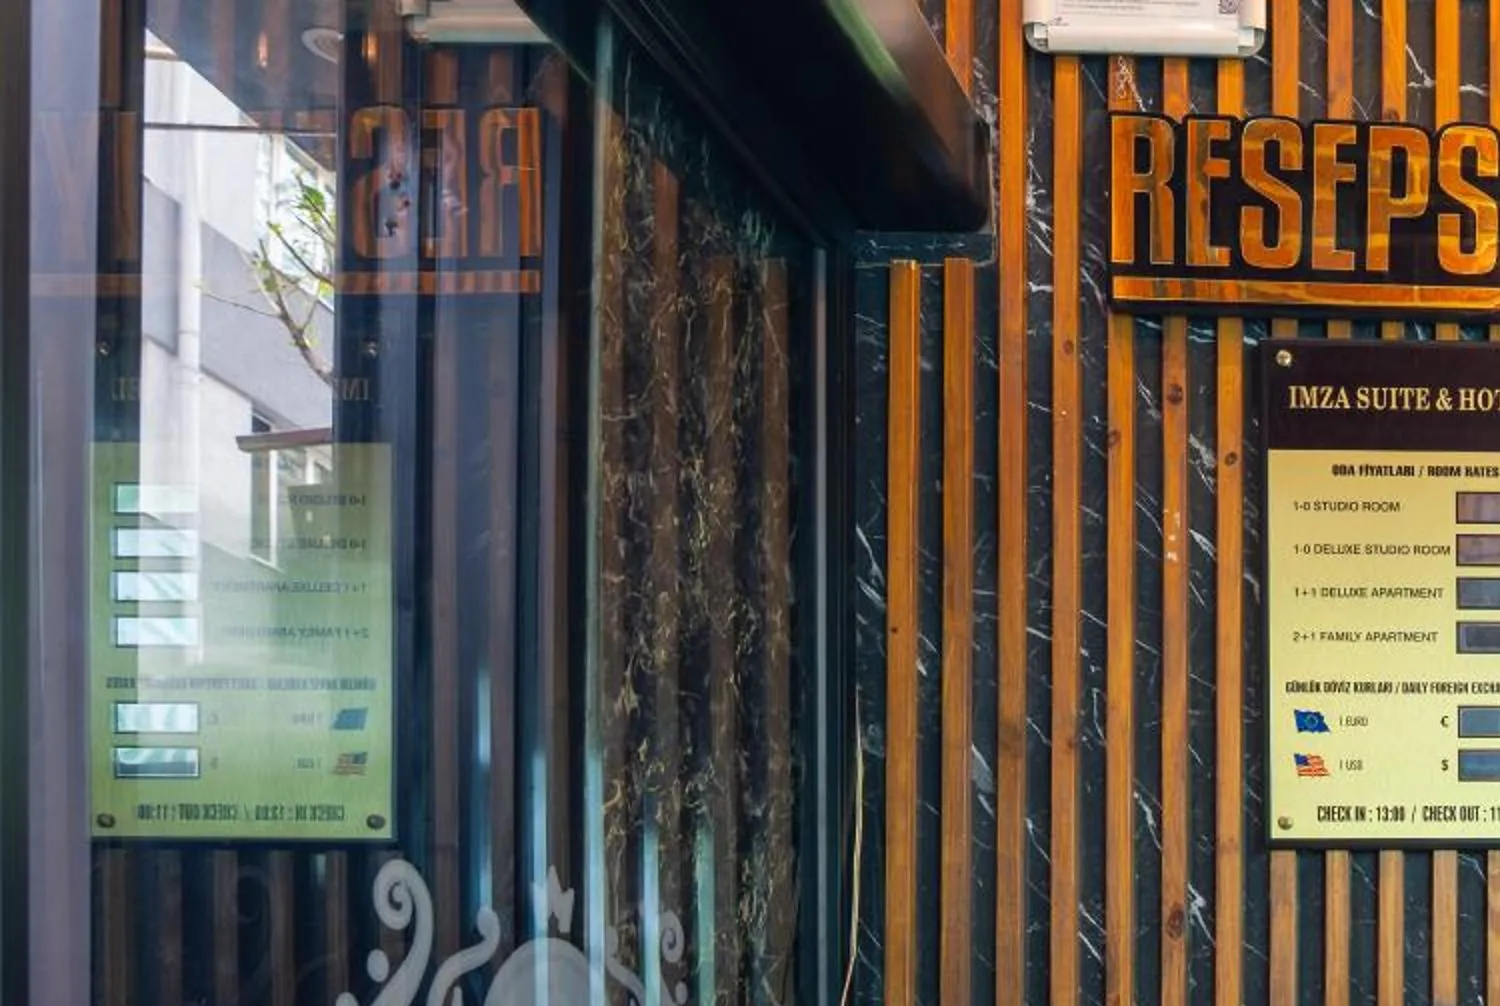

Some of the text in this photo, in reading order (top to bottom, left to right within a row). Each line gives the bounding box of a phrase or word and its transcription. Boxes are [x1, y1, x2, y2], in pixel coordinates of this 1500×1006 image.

[1288, 385, 1351, 410] IMZA
[1356, 386, 1431, 411] SUITE
[1435, 387, 1453, 411] &
[1332, 464, 1355, 477] ODA
[1427, 465, 1461, 477] ROOM
[1465, 465, 1500, 478] RATES
[1313, 501, 1359, 512] STUDIO
[1362, 501, 1401, 512] ROOM
[1313, 544, 1361, 555] DELUXE
[1364, 544, 1411, 555] STUDIO
[1413, 545, 1451, 556] ROOM
[1320, 587, 1368, 598] DELUXE
[1371, 587, 1444, 599] APARTMENT
[1319, 631, 1363, 642] FAMILY
[1365, 631, 1439, 643] APARTMENT
[1353, 681, 1393, 694] KURLARI
[1401, 681, 1428, 694] DAILY
[1430, 681, 1468, 694] FOREIGN
[1345, 715, 1368, 727] EURO
[1345, 759, 1364, 771] USD
[1317, 805, 1351, 822] CHECK
[1355, 805, 1366, 822] IN
[1376, 805, 1405, 822] 13:00
[1422, 806, 1457, 822] CHECK
[1459, 806, 1480, 822] OUT
